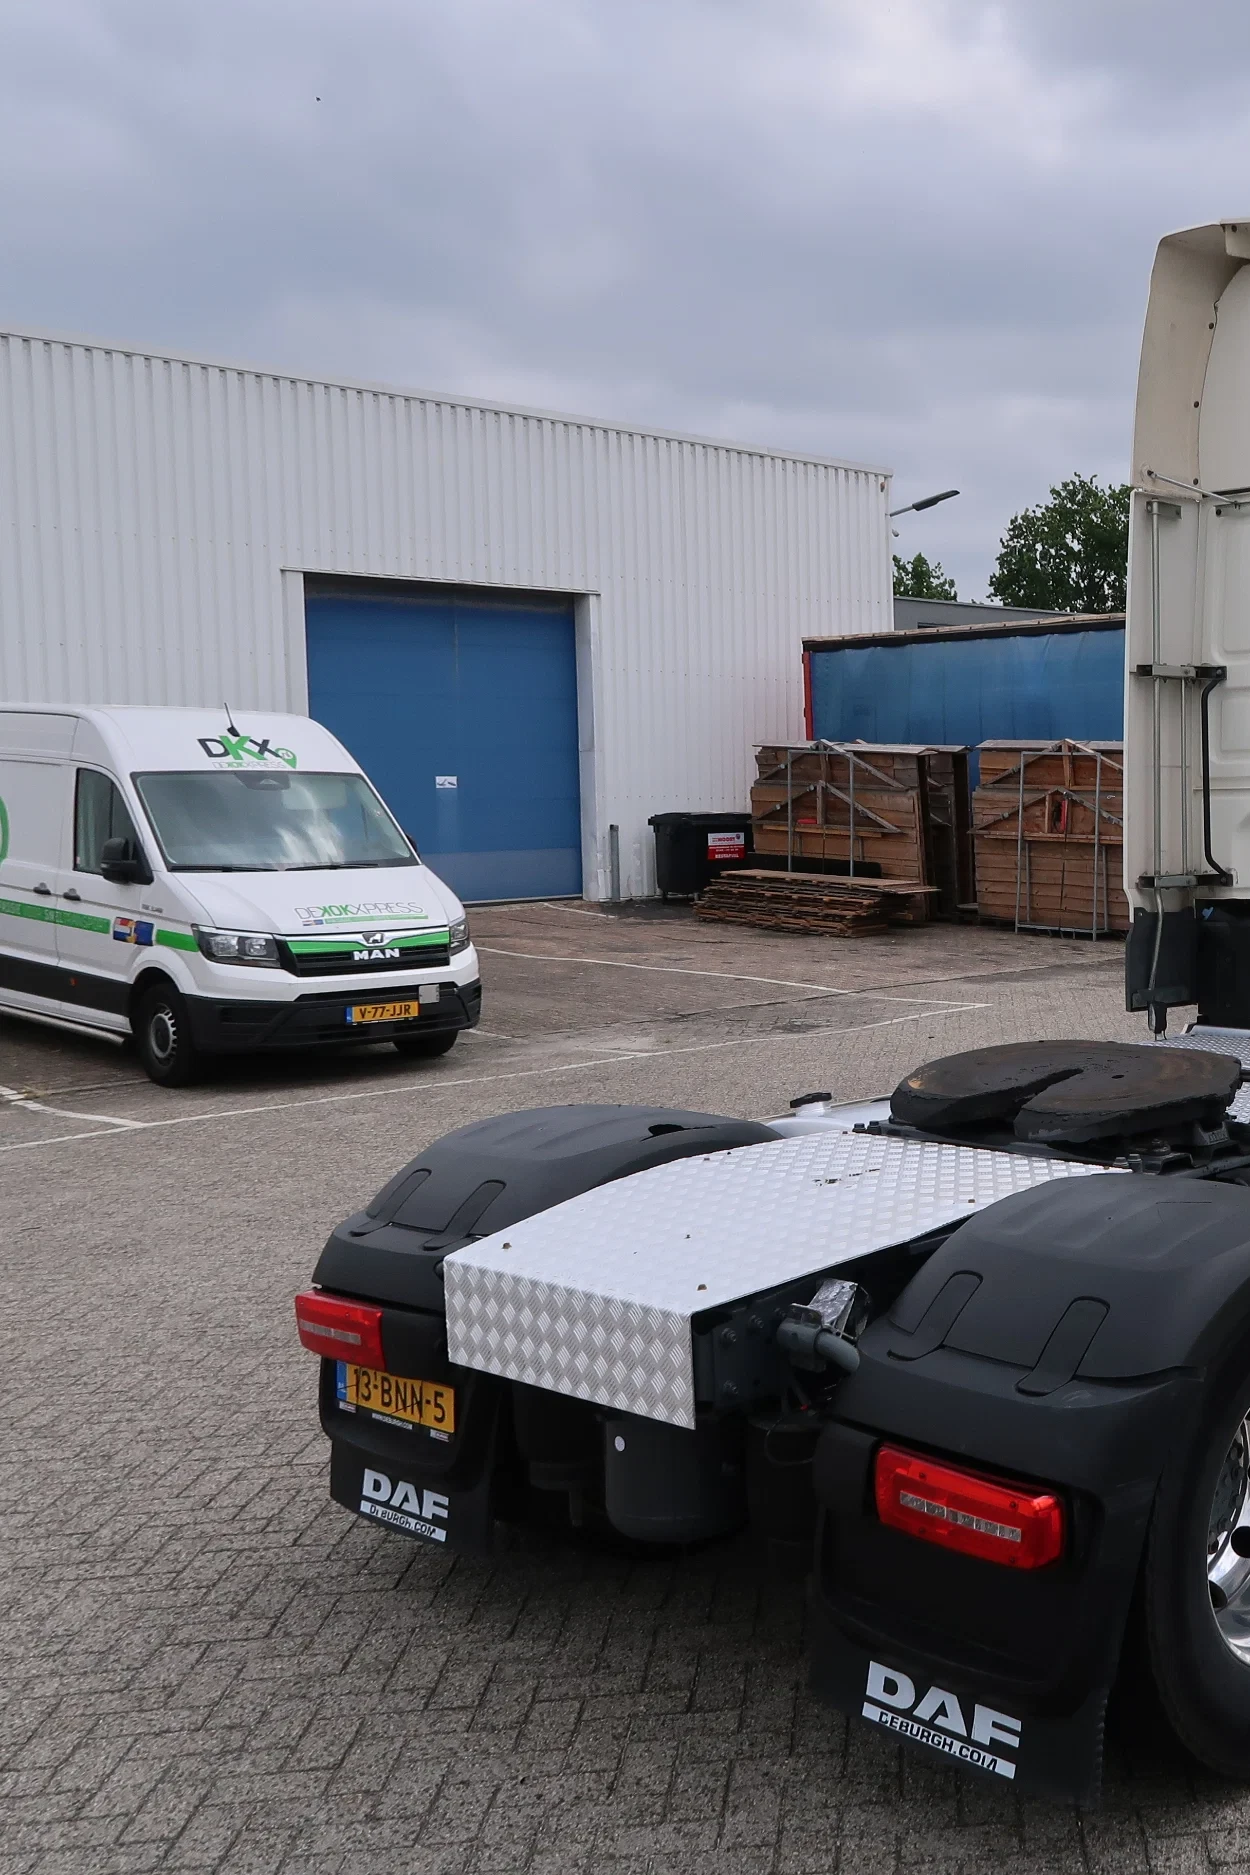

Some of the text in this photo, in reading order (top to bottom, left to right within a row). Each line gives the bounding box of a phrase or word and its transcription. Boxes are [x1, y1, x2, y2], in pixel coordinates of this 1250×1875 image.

[294, 901, 424, 920] DEKOKXPRESS
[353, 948, 400, 961] MAN
[359, 1004, 411, 1019] V-77-JJR
[353, 1369, 446, 1424] 13-BNN-5
[362, 1468, 449, 1519] DAF
[866, 1660, 1022, 1748] DAF
